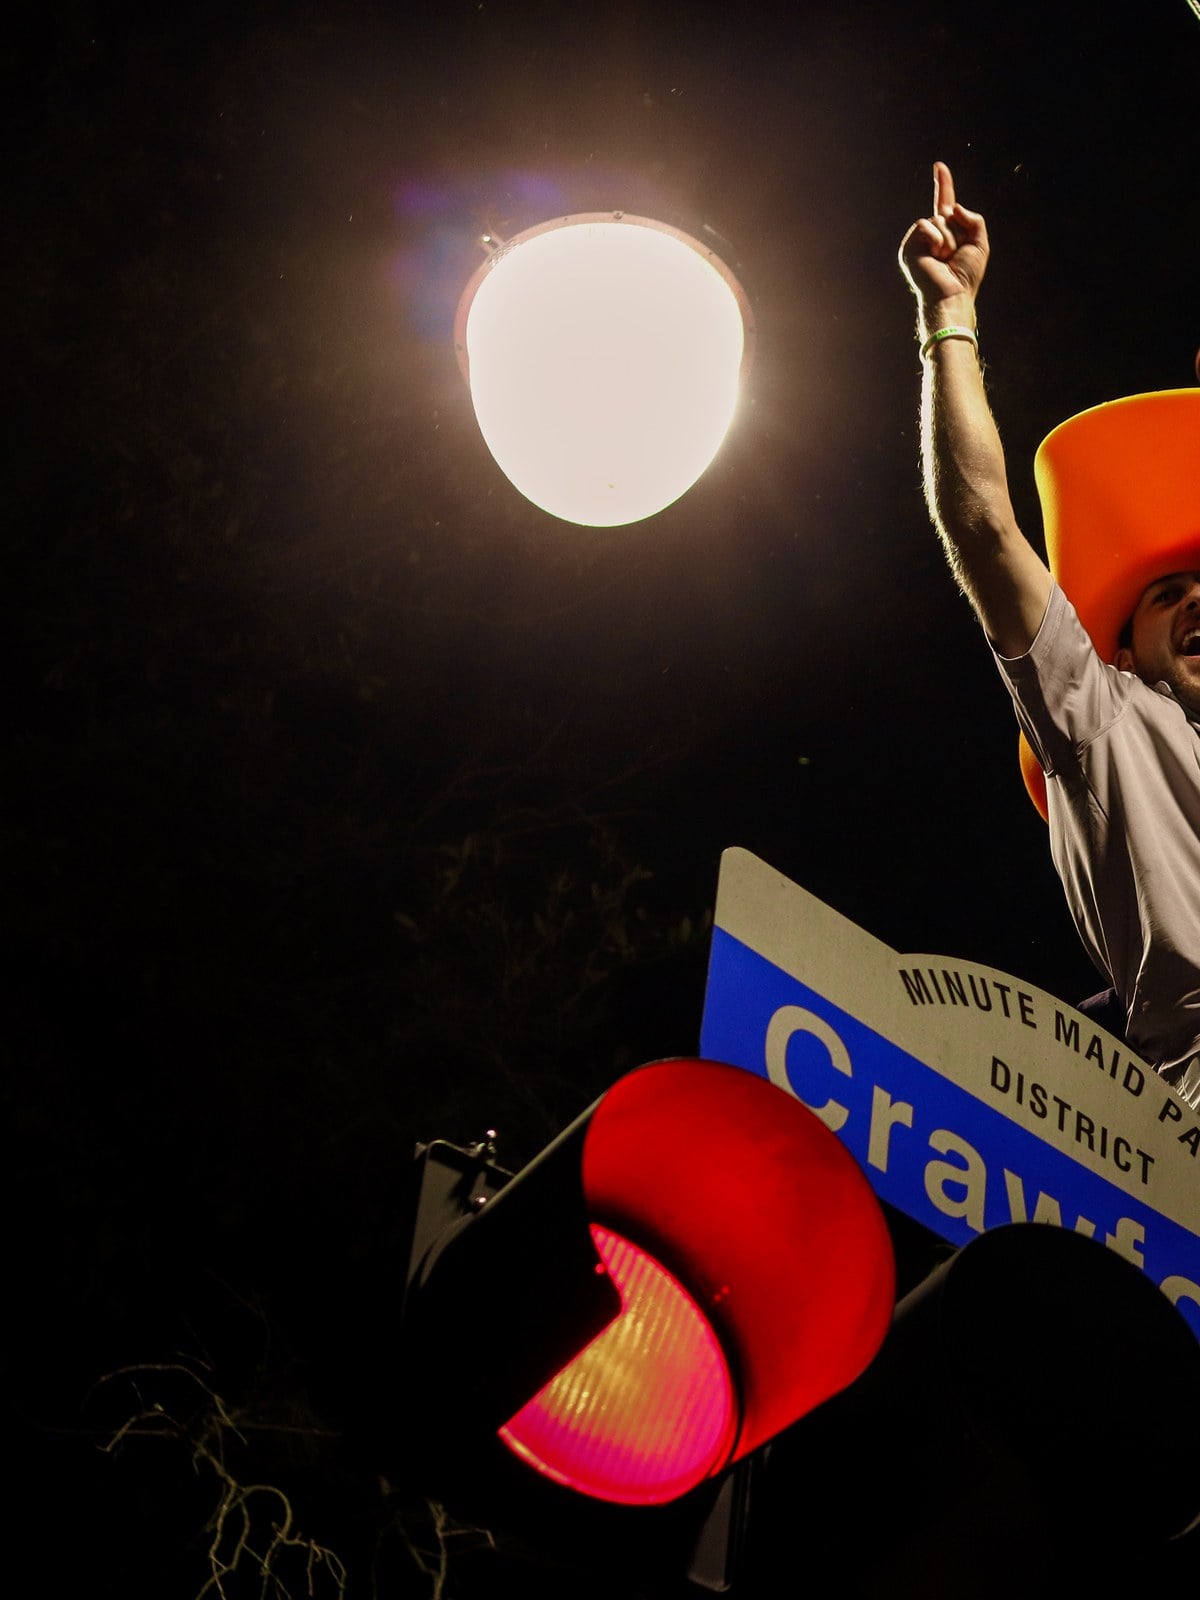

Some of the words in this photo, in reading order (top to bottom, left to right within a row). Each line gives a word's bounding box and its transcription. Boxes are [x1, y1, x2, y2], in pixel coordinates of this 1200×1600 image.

[899, 968, 1037, 1029] MINUTE
[1055, 1010, 1145, 1097] MAID
[991, 1055, 1155, 1185] DISTRICT
